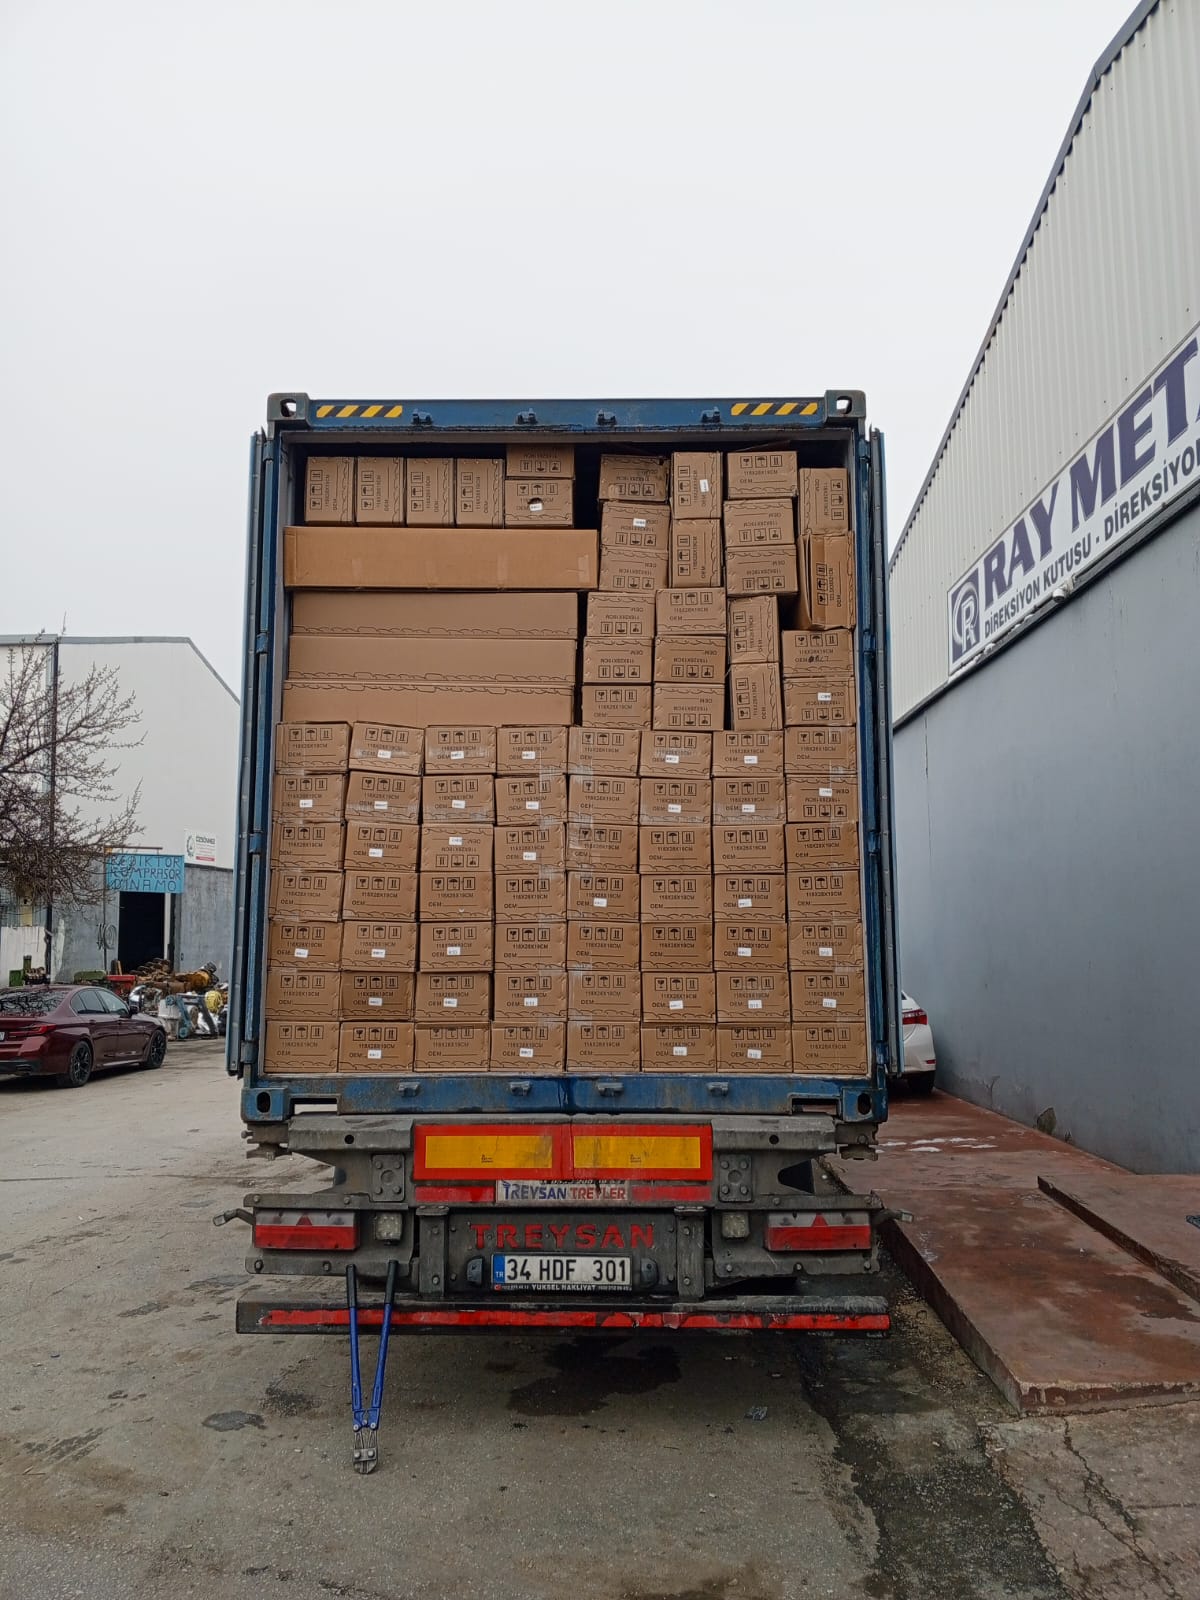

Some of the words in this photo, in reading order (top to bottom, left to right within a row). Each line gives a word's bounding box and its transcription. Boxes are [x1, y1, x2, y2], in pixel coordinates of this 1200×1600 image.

[1070, 337, 1200, 533] MET
[985, 576, 1040, 639] DİREKSİYON
[1043, 532, 1091, 591] KUTUSU
[1105, 438, 1200, 542] DİREKSİYO
[502, 1181, 566, 1200] TREYSAN
[570, 1187, 626, 1200] TREYLER
[470, 1224, 654, 1249] TREYSAN
[507, 1259, 531, 1281] 34
[539, 1260, 577, 1281] HDF
[592, 1260, 626, 1281] 301
